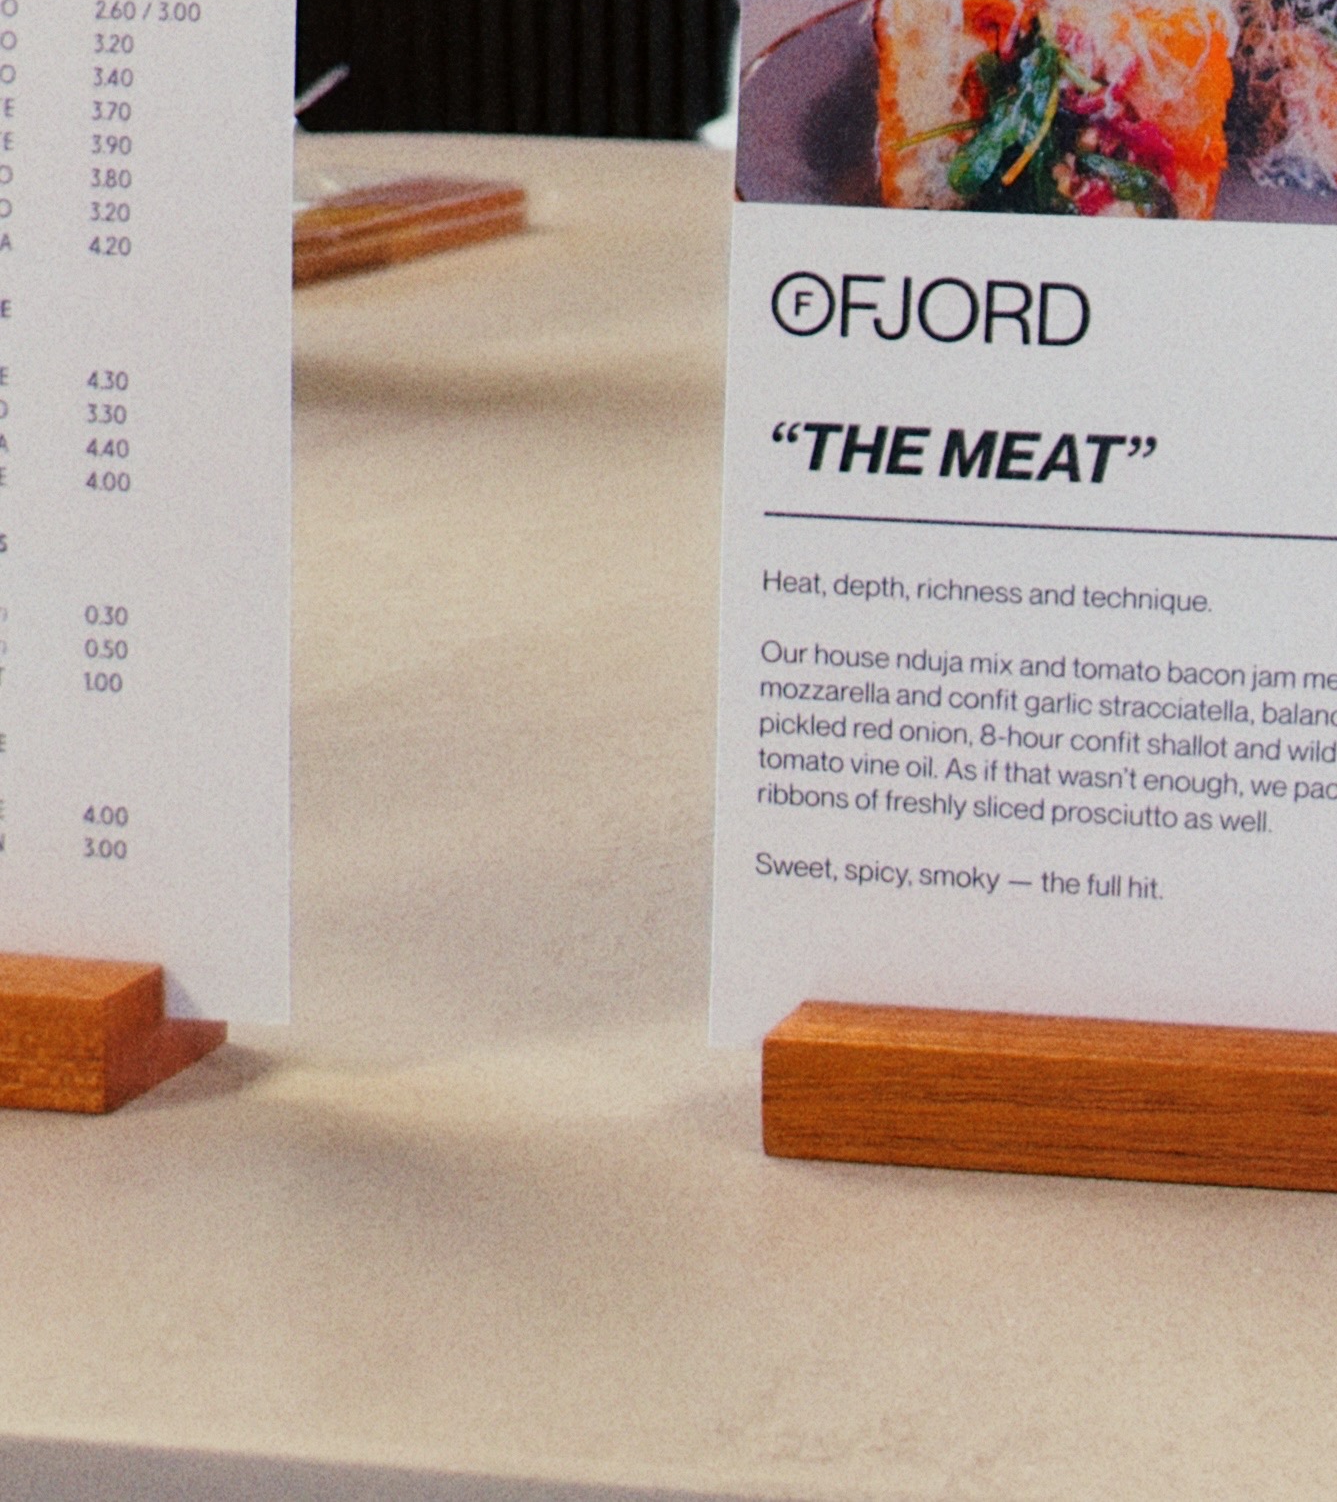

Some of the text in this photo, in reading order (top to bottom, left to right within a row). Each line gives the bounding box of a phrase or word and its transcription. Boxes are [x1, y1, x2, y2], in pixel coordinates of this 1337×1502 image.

[95, 0, 136, 20] 2.60
[159, 2, 201, 22] 3.00
[95, 33, 134, 54] 3.20
[94, 67, 133, 87] 3.40
[93, 101, 131, 122] 3.70
[92, 134, 132, 155] 3.90
[92, 168, 131, 189] 3.80
[91, 202, 130, 222] 3.20
[89, 236, 131, 256] 4.20
[840, 274, 1092, 348] FJORD
[87, 370, 128, 391] 4.30
[88, 403, 127, 425] 3.30
[86, 438, 129, 458] 4.40
[772, 422, 1157, 484] “THE MEAT”
[85, 471, 131, 492] 4.00
[762, 569, 1211, 616] Heat, depth, richness and technique.
[85, 605, 128, 626] 0.30
[85, 639, 128, 660] 0.50
[760, 639, 808, 664] Our
[814, 643, 890, 669] house
[896, 649, 963, 677] nduja
[970, 657, 1012, 675] mix
[1019, 656, 1066, 679] and
[1072, 657, 1161, 683] tomato
[1167, 661, 1246, 687] bacon
[1250, 670, 1296, 692] jam
[84, 672, 123, 693] 1.00
[760, 681, 890, 705] mozzarella
[895, 685, 942, 708] and
[948, 688, 1018, 712] confit
[1024, 692, 1092, 718] garlic
[1099, 695, 1255, 725] stracciatella,
[83, 806, 128, 827] 4.00
[757, 783, 1271, 833] ribbons of freshly sliced prosciutto as well.
[85, 838, 127, 859] 3.00
[755, 851, 838, 882] Sweet,
[845, 863, 912, 889] spicy,
[919, 866, 1000, 895] smoky
[1041, 871, 1081, 895] the
[1087, 873, 1122, 897] full
[1128, 876, 1163, 900] hit.
